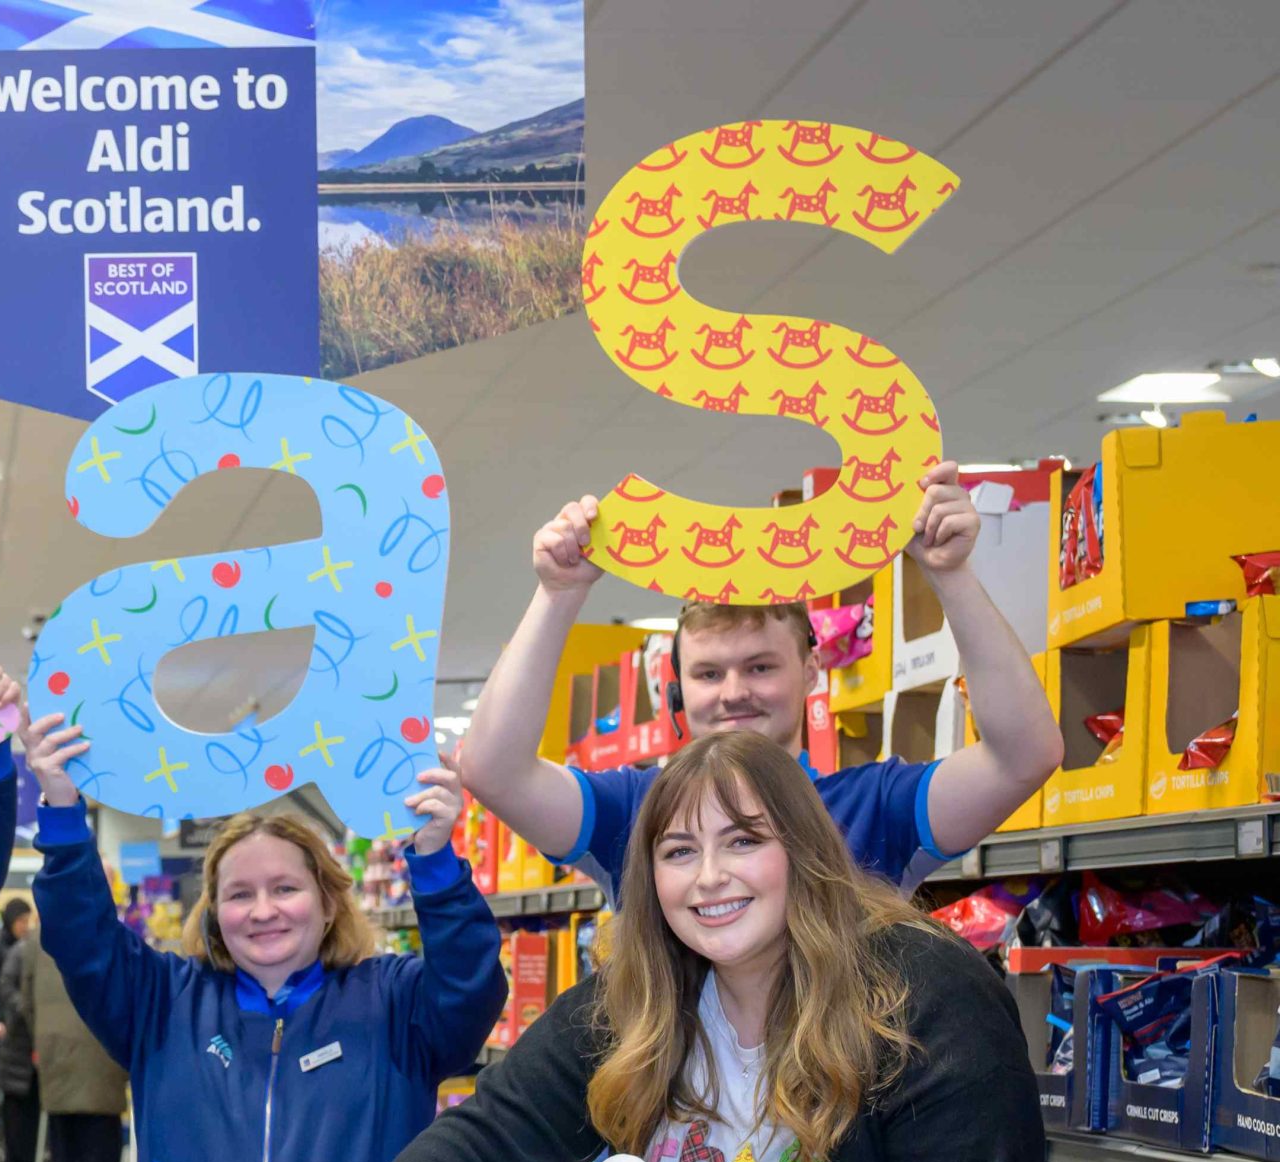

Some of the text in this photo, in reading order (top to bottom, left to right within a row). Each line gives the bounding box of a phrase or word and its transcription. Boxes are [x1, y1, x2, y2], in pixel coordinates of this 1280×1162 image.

[232, 67, 288, 110] to
[86, 121, 190, 172] Aldi
[17, 185, 261, 234] Scotland.
[107, 262, 175, 278] BEST OF
[94, 280, 188, 296] SCOTLAND
[1172, 774, 1206, 790] TORTILLA
[1064, 784, 1115, 804] TORTILLA CHIPS
[1049, 1093, 1066, 1107] CRISPS
[1126, 1104, 1179, 1124] CRINKLE CUT CRISPS
